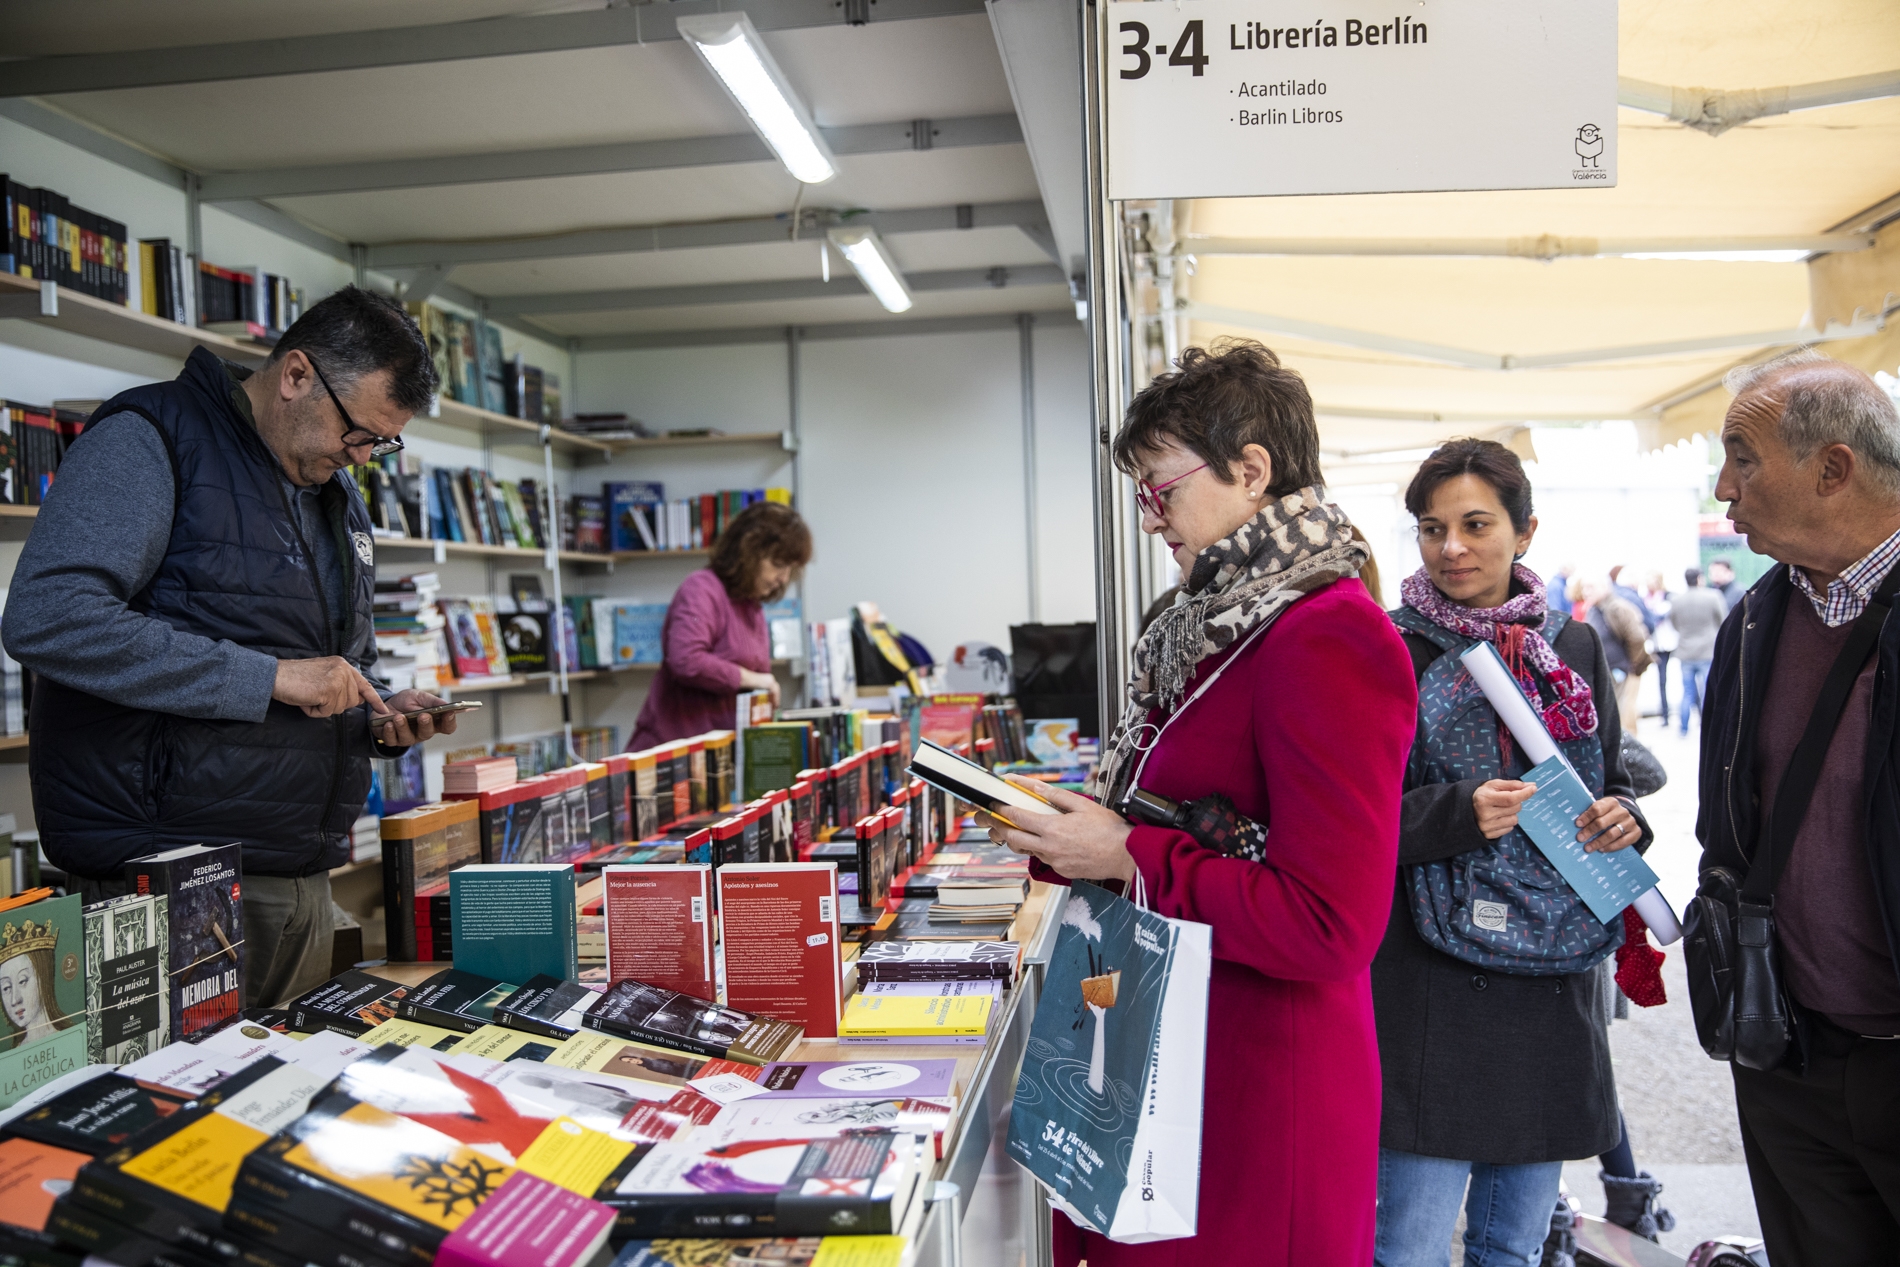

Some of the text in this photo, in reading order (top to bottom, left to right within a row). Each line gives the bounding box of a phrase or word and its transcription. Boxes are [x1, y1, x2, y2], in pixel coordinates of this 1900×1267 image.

[1229, 15, 1429, 51] Librería Berlín
[1119, 19, 1210, 80] 3-4
[1238, 79, 1328, 98] Acantilado
[1238, 106, 1343, 127] Barlin Libros
[179, 868, 235, 891] JIMÉNEZ LOSANTOS
[193, 862, 223, 877] FEDERICO
[609, 881, 626, 889] Mejor
[723, 882, 750, 890] Apóstoles
[127, 959, 146, 971] AUSTER
[112, 976, 150, 997] La música
[182, 968, 239, 1009] MEMORIA DEL
[333, 983, 378, 1007] COMENDADOR
[182, 989, 239, 1036] COMUNISMO
[665, 1039, 679, 1047] NADA
[23, 1046, 58, 1071] ISABEL
[169, 1058, 204, 1077] Mendoza
[4, 1057, 75, 1096] LA CATÓLICA
[57, 1086, 139, 1130] Juan José Millás
[230, 1100, 261, 1120] Jorge
[249, 1096, 299, 1127] Fernández
[1041, 1119, 1065, 1149] 54
[1066, 1131, 1083, 1147] Fira
[1062, 1143, 1073, 1156] de
